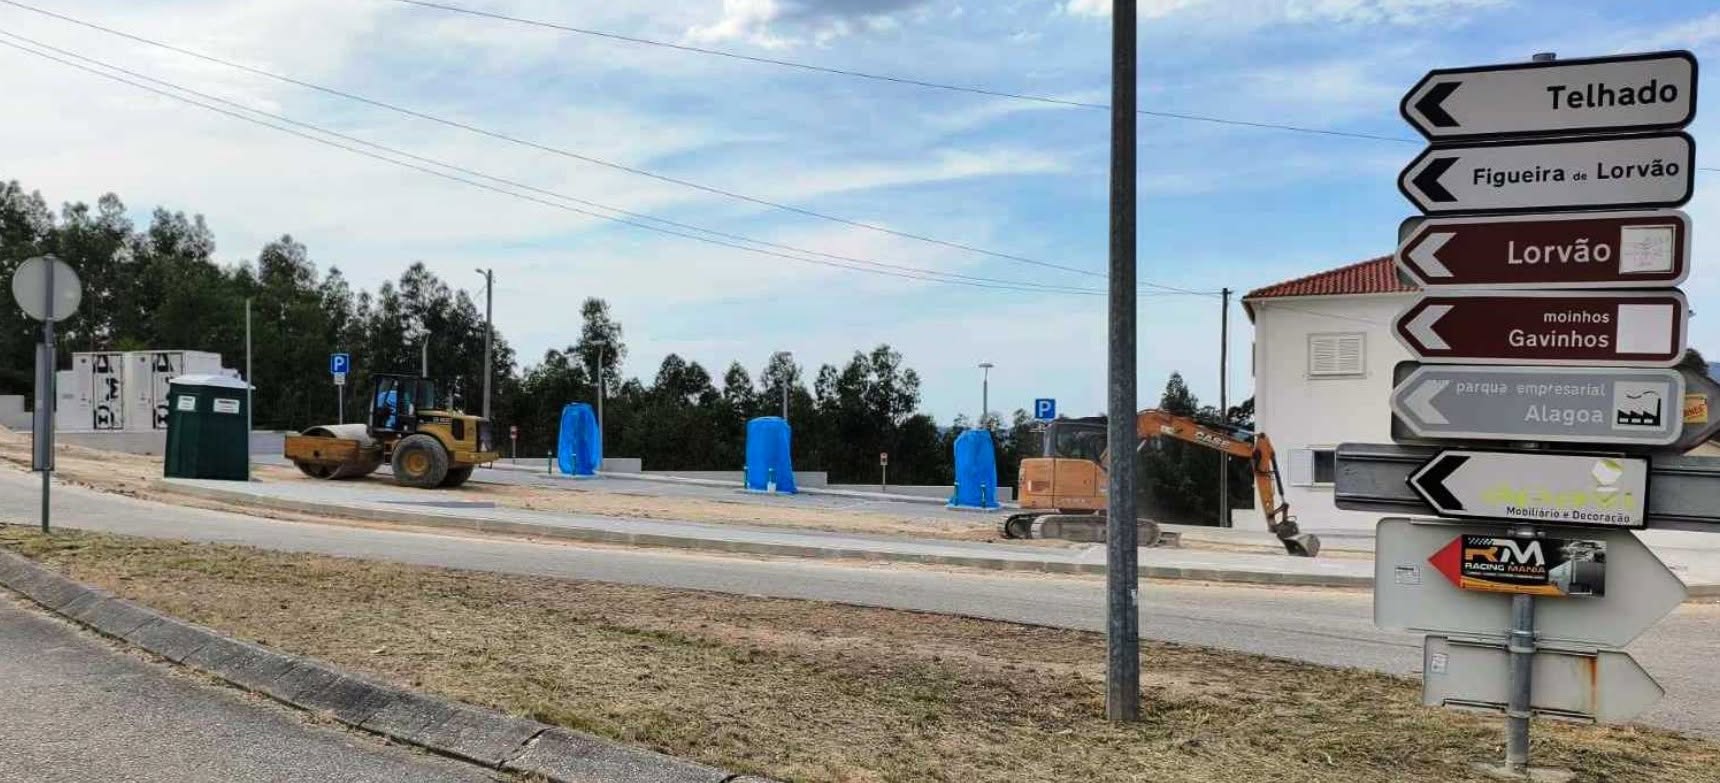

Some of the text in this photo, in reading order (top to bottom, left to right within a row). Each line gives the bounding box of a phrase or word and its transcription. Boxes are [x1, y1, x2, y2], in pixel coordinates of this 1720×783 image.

[1547, 80, 1678, 110] Telhado
[1473, 159, 1680, 188] Figueira de Lorvão
[1507, 238, 1612, 265] Lorvão
[1543, 310, 1610, 324] moinhos
[1508, 329, 1610, 348] Gavinhos
[334, 356, 345, 371] P
[1517, 382, 1606, 397] empresarial
[1038, 401, 1051, 417] P
[1524, 405, 1604, 426] Alagoa
[1195, 431, 1231, 449] CASE
[1506, 506, 1560, 518] Mobiliário
[1572, 510, 1630, 523] Decoração
[1464, 562, 1505, 571] RACING
